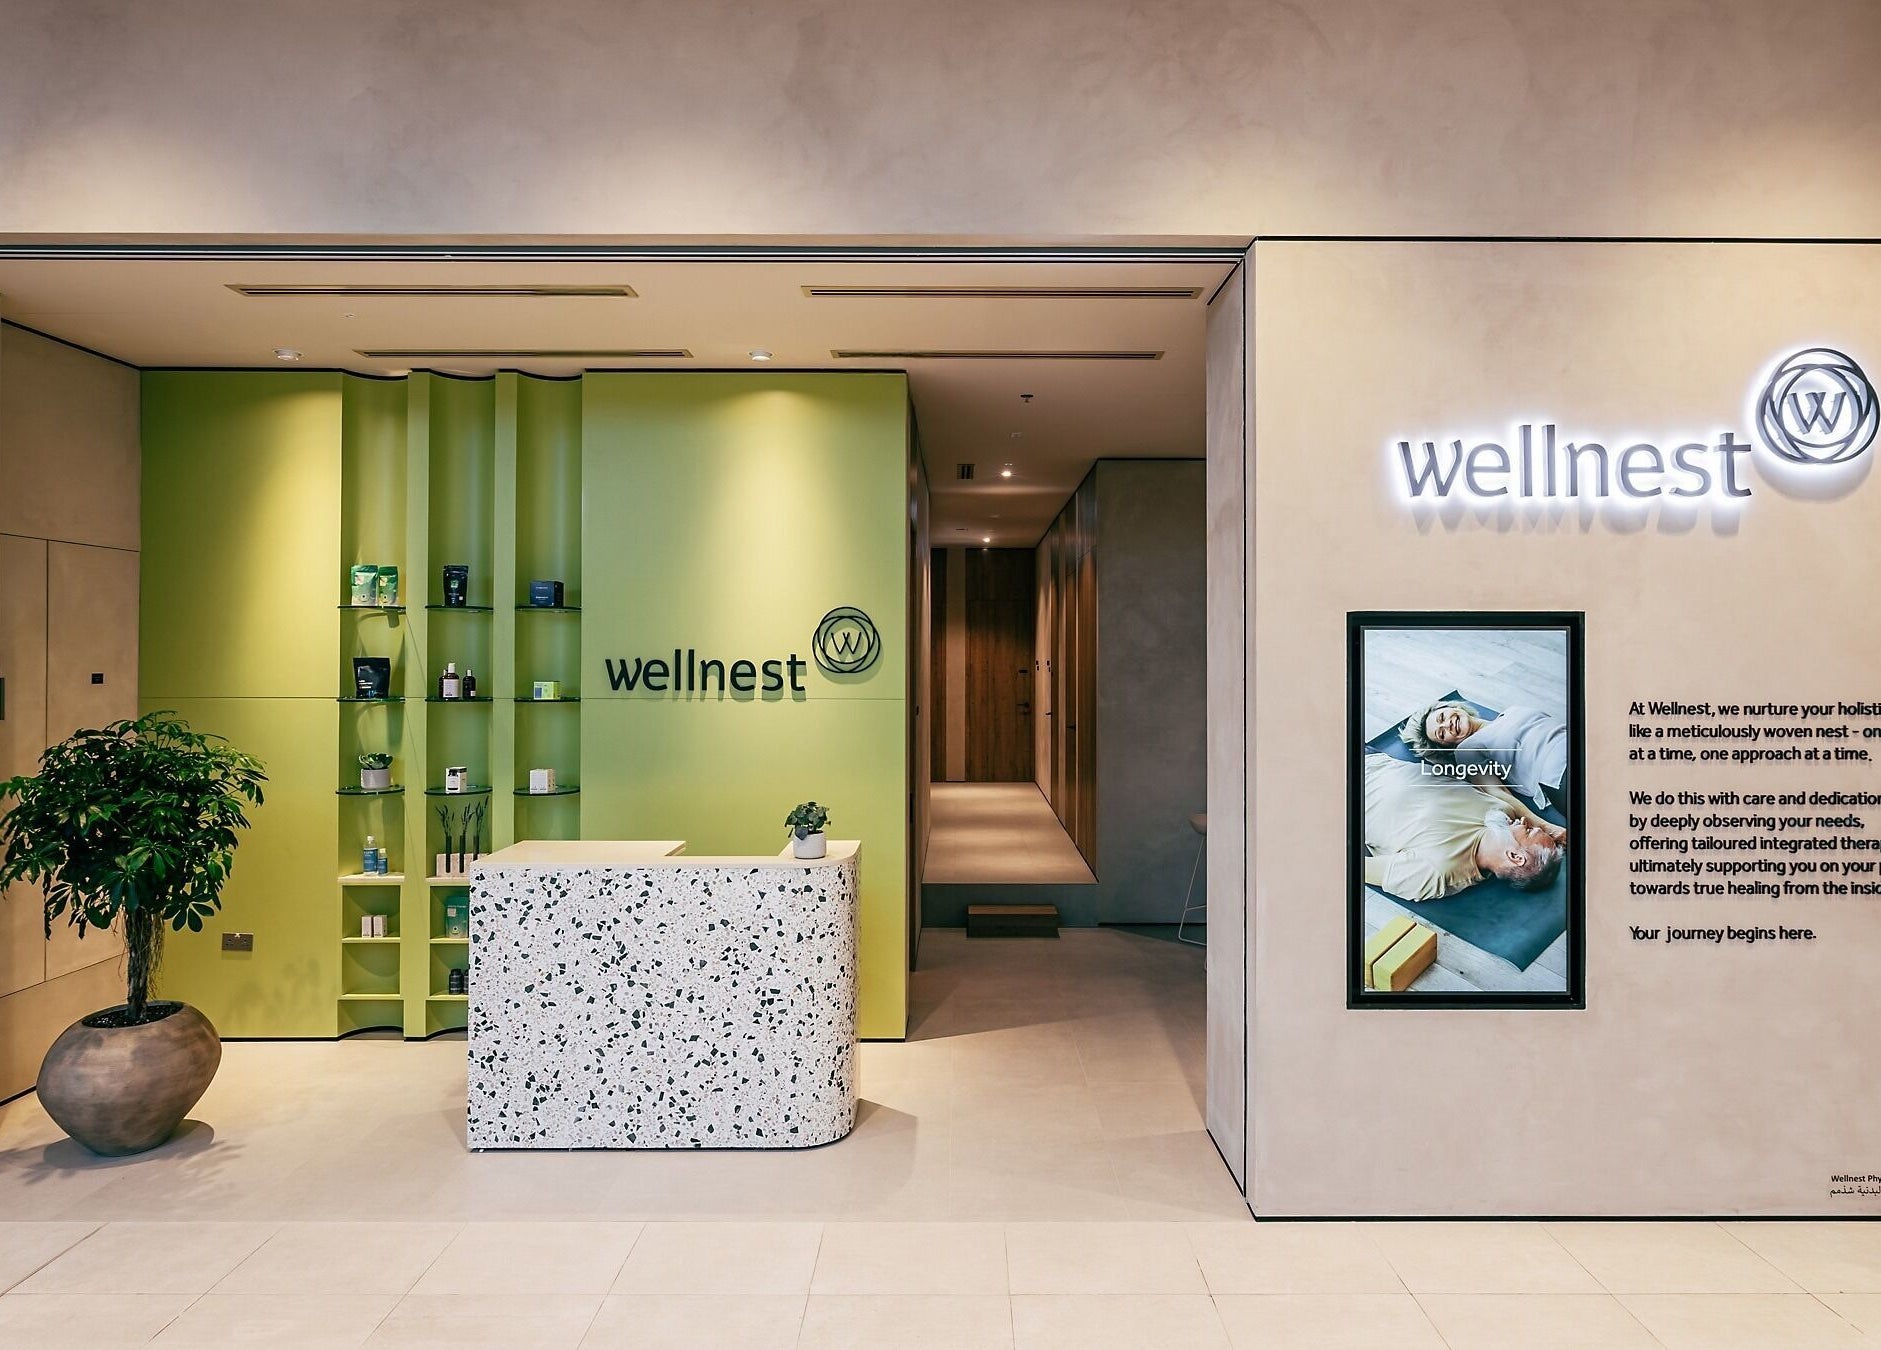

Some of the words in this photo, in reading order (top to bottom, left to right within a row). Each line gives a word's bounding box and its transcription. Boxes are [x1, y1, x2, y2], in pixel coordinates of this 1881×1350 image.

[1396, 423, 1753, 498] wellnest
[604, 648, 807, 692] wellnest
[1628, 701, 1646, 716] At
[1647, 701, 1716, 718] Wellnest,
[1717, 704, 1740, 716] we
[1743, 702, 1799, 716] nurture
[1800, 704, 1836, 720] your
[1629, 723, 1653, 738] like
[1654, 727, 1664, 738] a
[1666, 724, 1762, 742] meticulously
[1762, 727, 1813, 738] woven
[1815, 724, 1850, 739] nest
[1628, 747, 1645, 761] at
[1647, 749, 1657, 761] a
[1658, 747, 1697, 762] time,
[1700, 749, 1729, 761] one
[1731, 745, 1802, 764] approach
[1804, 747, 1821, 761] at
[1822, 749, 1832, 761] a
[1833, 746, 1873, 762] time.
[1421, 759, 1512, 781] Longevity
[1629, 790, 1653, 806] We
[1655, 790, 1675, 806] do
[1677, 790, 1706, 806] this
[1707, 790, 1740, 806] with
[1742, 794, 1776, 806] care
[1778, 790, 1806, 806] and
[1629, 813, 1648, 832] by
[1650, 813, 1701, 832] deeply
[1702, 813, 1776, 832] observing
[1778, 816, 1814, 832] your
[1815, 813, 1865, 829] needs,
[1629, 835, 1689, 854] offering
[1690, 835, 1757, 851] tailoured
[1759, 835, 1838, 854] integrated
[1839, 835, 1881, 853] thera
[1629, 858, 1704, 877] ultimately
[1705, 858, 1787, 877] supporting
[1788, 861, 1817, 877] you
[1841, 861, 1877, 877] your
[1629, 880, 1691, 895] towards
[1692, 881, 1725, 895] true
[1727, 880, 1781, 899] healing
[1782, 880, 1820, 895] from
[1821, 880, 1849, 895] the
[1629, 925, 1661, 941] Your
[1665, 925, 1725, 944] journey
[1726, 925, 1777, 944] begins
[1778, 925, 1817, 940] here.
[1830, 1174, 1866, 1183] Wellnest
